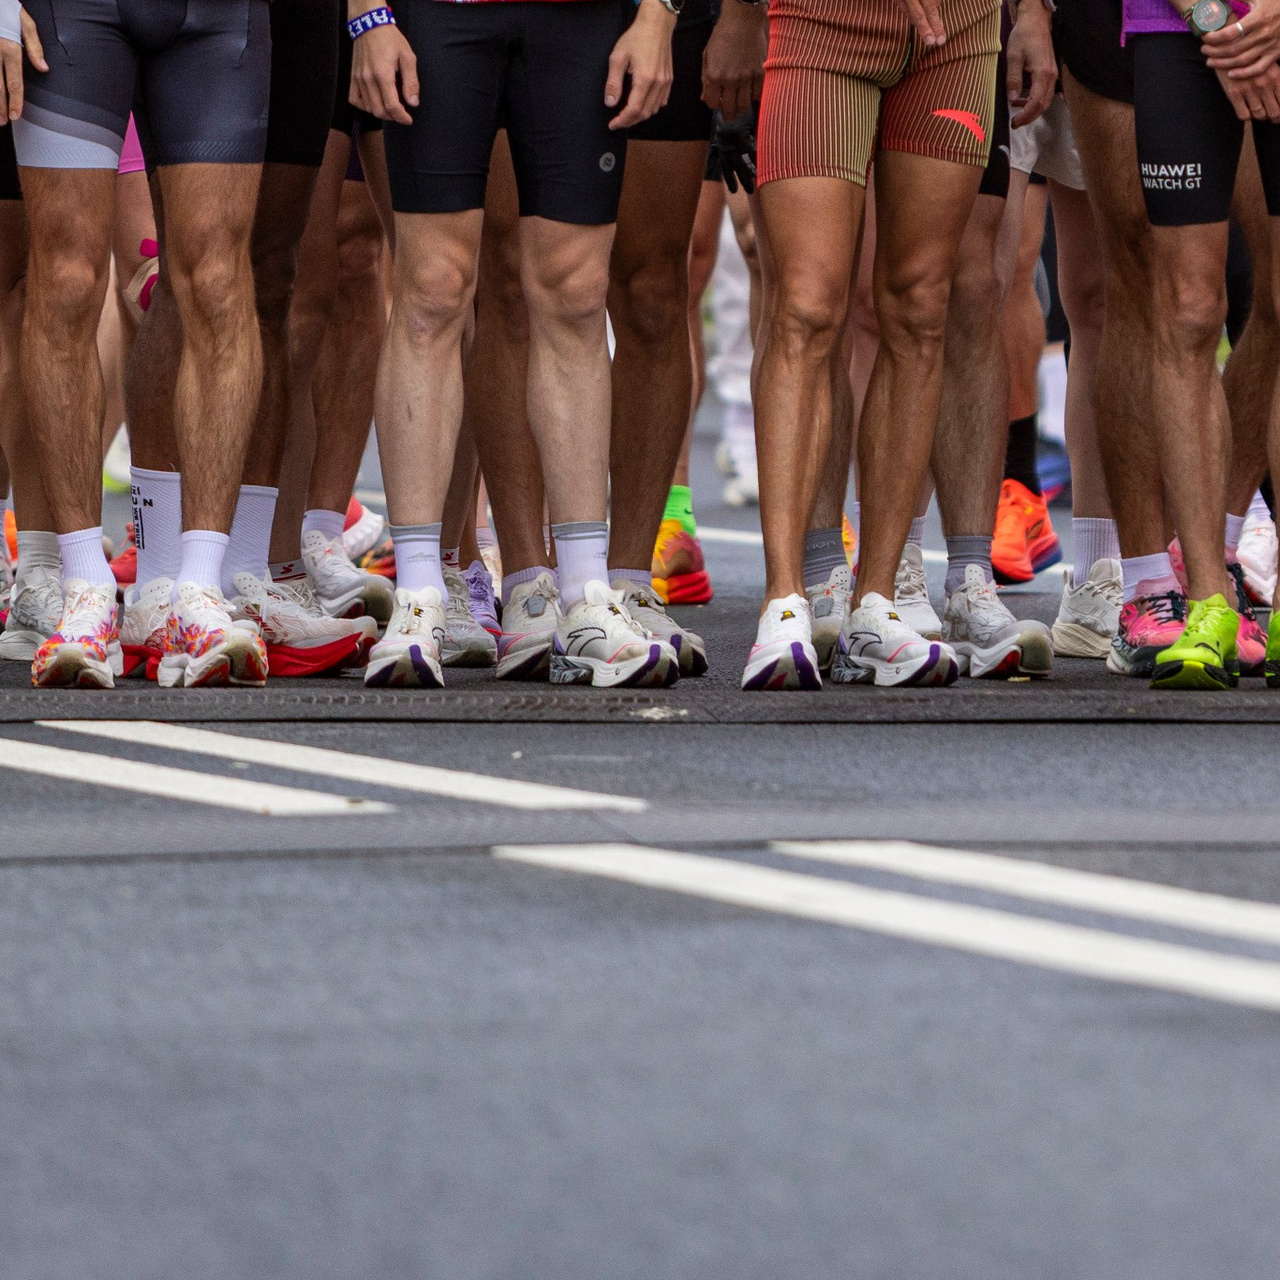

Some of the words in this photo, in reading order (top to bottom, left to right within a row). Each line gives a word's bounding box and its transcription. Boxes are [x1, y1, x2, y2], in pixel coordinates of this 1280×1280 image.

[1141, 163, 1201, 176] HUAWEI
[1143, 178, 1182, 190] WATCH
[1185, 177, 1201, 189] GT
